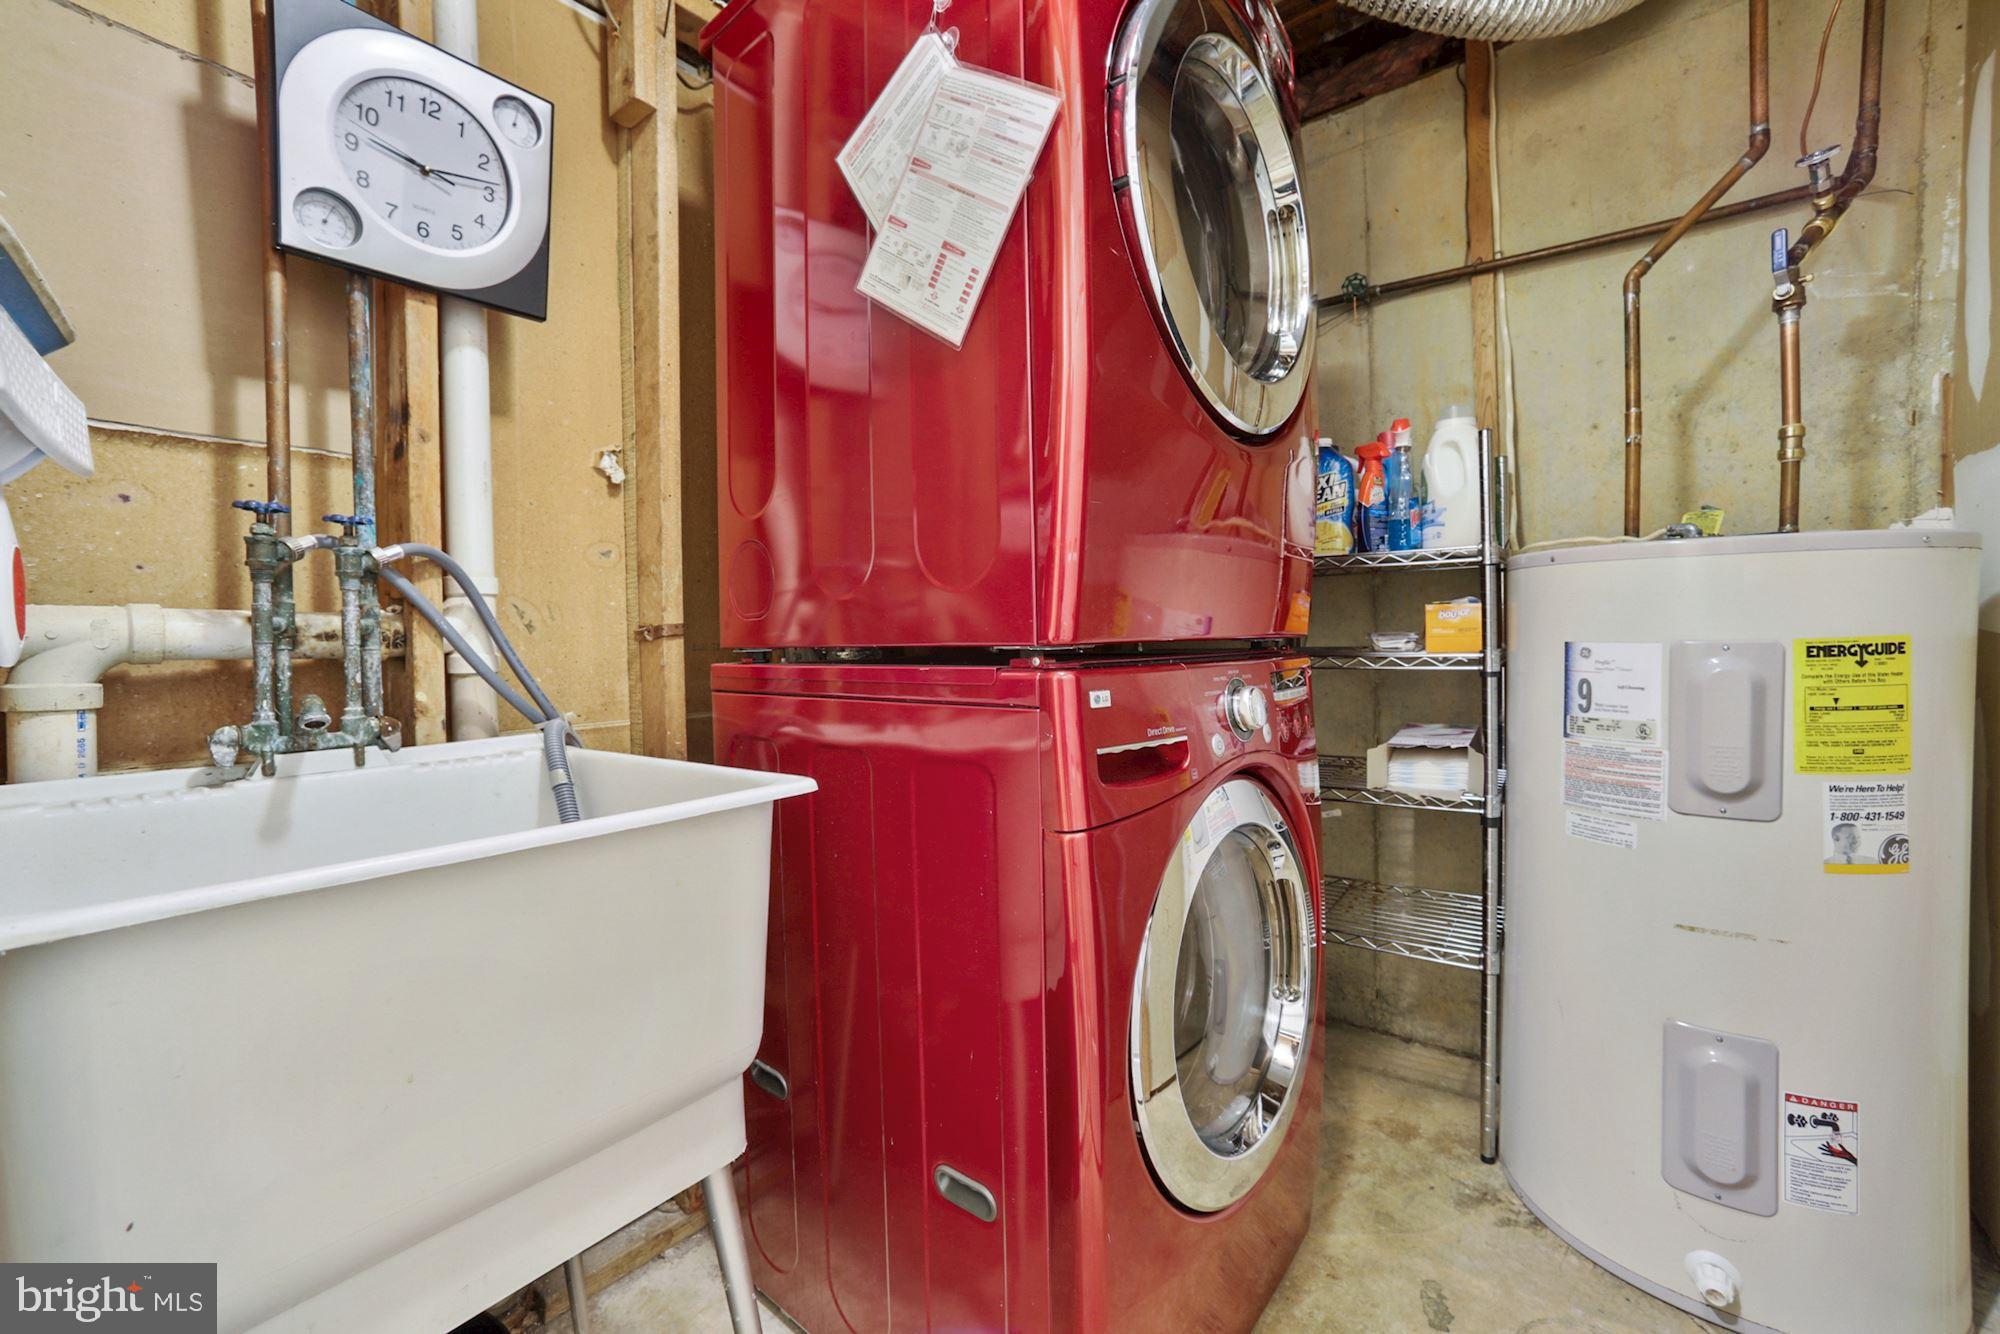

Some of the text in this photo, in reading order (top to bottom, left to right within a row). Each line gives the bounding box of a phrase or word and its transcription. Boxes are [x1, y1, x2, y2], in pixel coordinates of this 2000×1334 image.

[384, 90, 405, 113] 11
[418, 96, 442, 120] 12
[354, 103, 380, 127] 10
[457, 122, 465, 138] 1
[344, 132, 359, 151] 9
[477, 153, 490, 171] 2
[356, 170, 370, 189] 8
[483, 185, 495, 203] 3
[384, 201, 398, 219] 7
[416, 221, 430, 239] 6
[474, 213, 486, 229] 4
[451, 224, 463, 241] 5
[1317, 472, 1336, 490] XI
[1317, 481, 1346, 504] EAN
[1806, 642, 1906, 662] ENERGYGUIDE
[1578, 678, 1592, 713] 9
[1147, 727, 1162, 737] Direct
[1162, 726, 1175, 735] Drive
[1829, 783, 1904, 793] We're Here To Help!
[1801, 1097, 1855, 1111] DANGER
